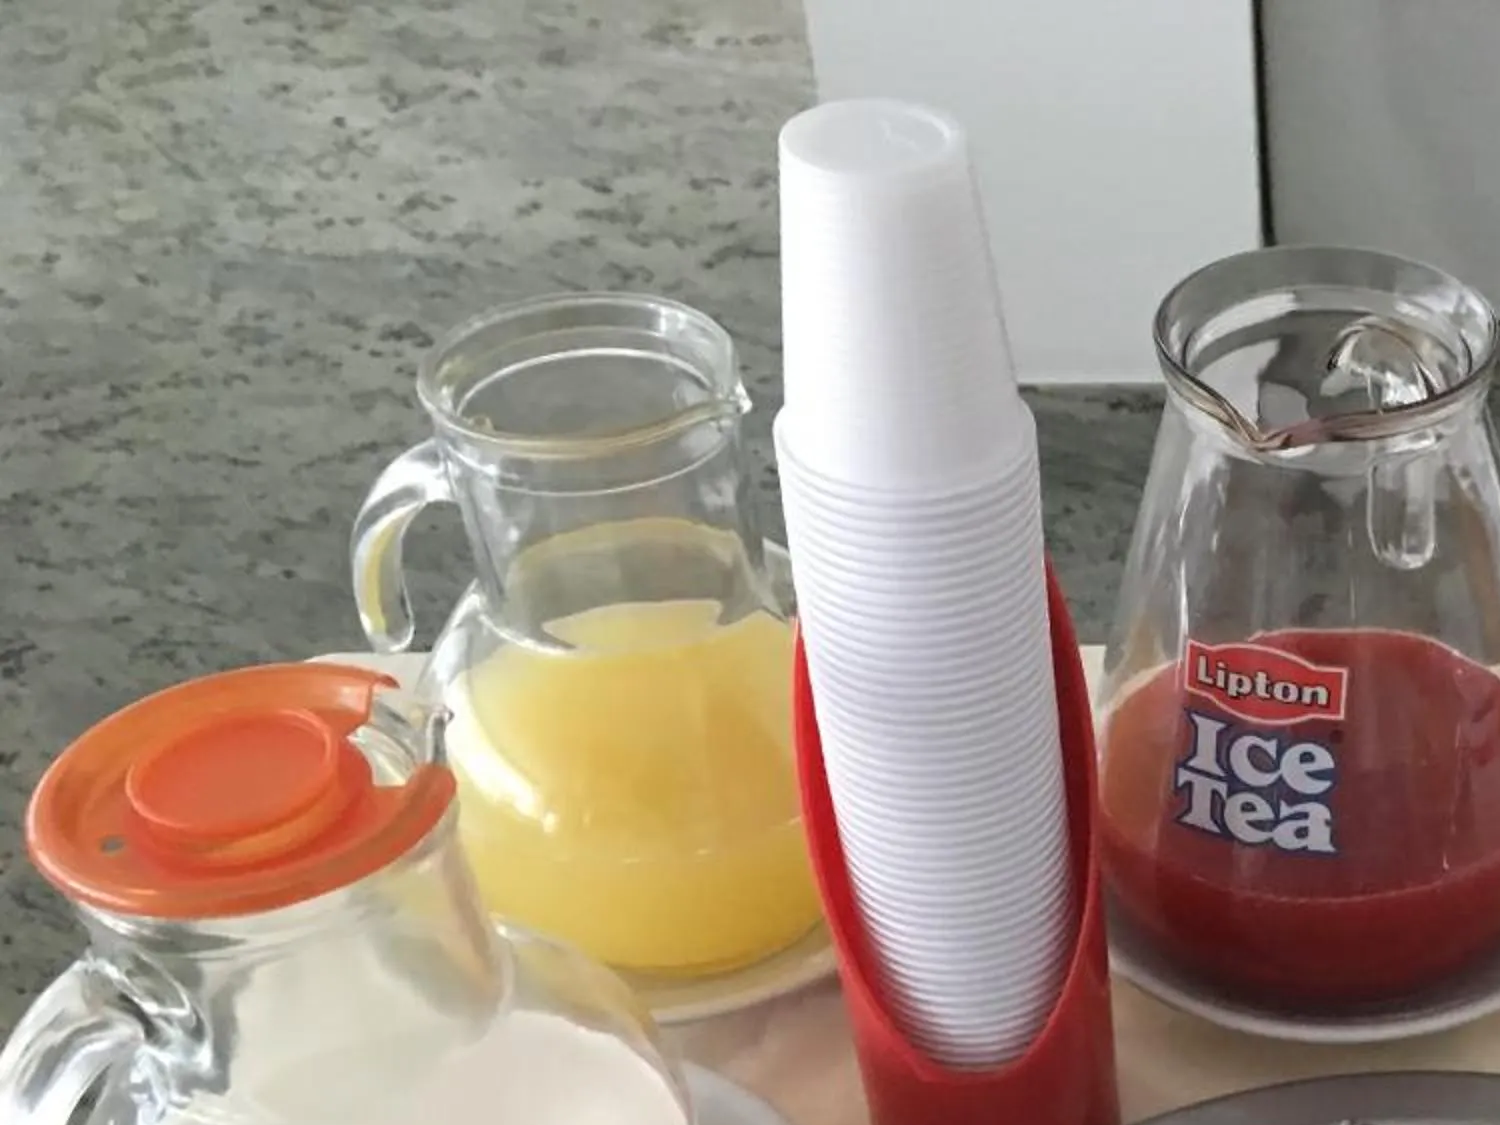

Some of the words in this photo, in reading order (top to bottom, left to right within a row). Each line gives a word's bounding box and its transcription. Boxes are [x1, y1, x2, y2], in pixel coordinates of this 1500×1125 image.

[1197, 655, 1329, 706] Lipton
[1188, 710, 1336, 796] Ice
[1177, 768, 1337, 854] Tea
